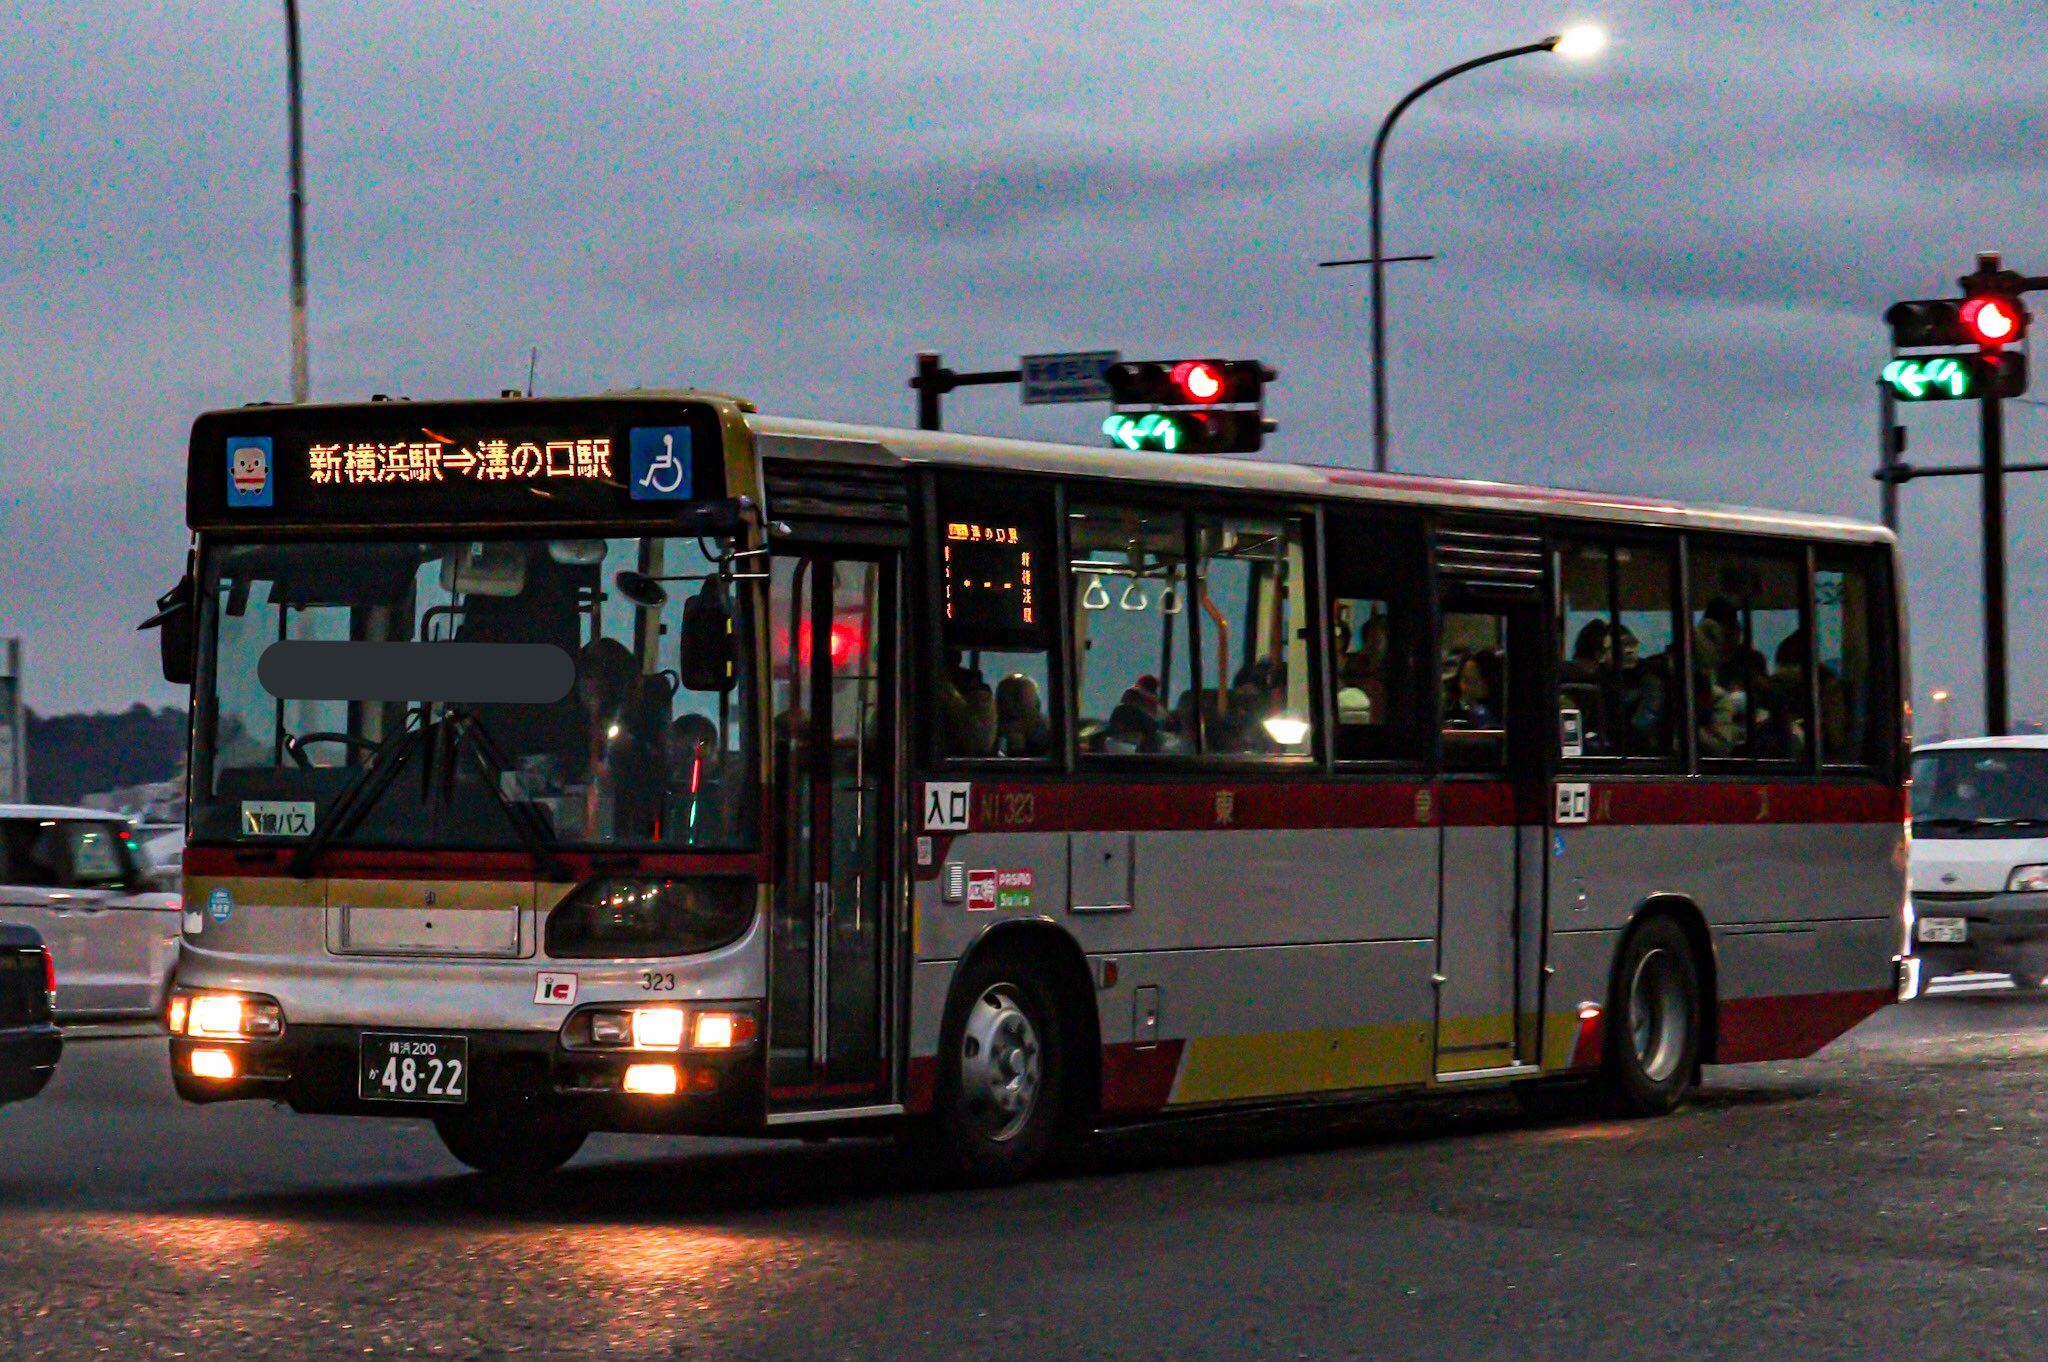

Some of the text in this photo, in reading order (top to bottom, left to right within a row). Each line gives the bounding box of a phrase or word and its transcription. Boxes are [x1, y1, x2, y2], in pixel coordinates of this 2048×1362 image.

[309, 439, 612, 483] 新横浜駅 溝の口駅
[928, 790, 967, 824] 入口
[642, 973, 675, 991] 323
[382, 1056, 463, 1096] 48-22
